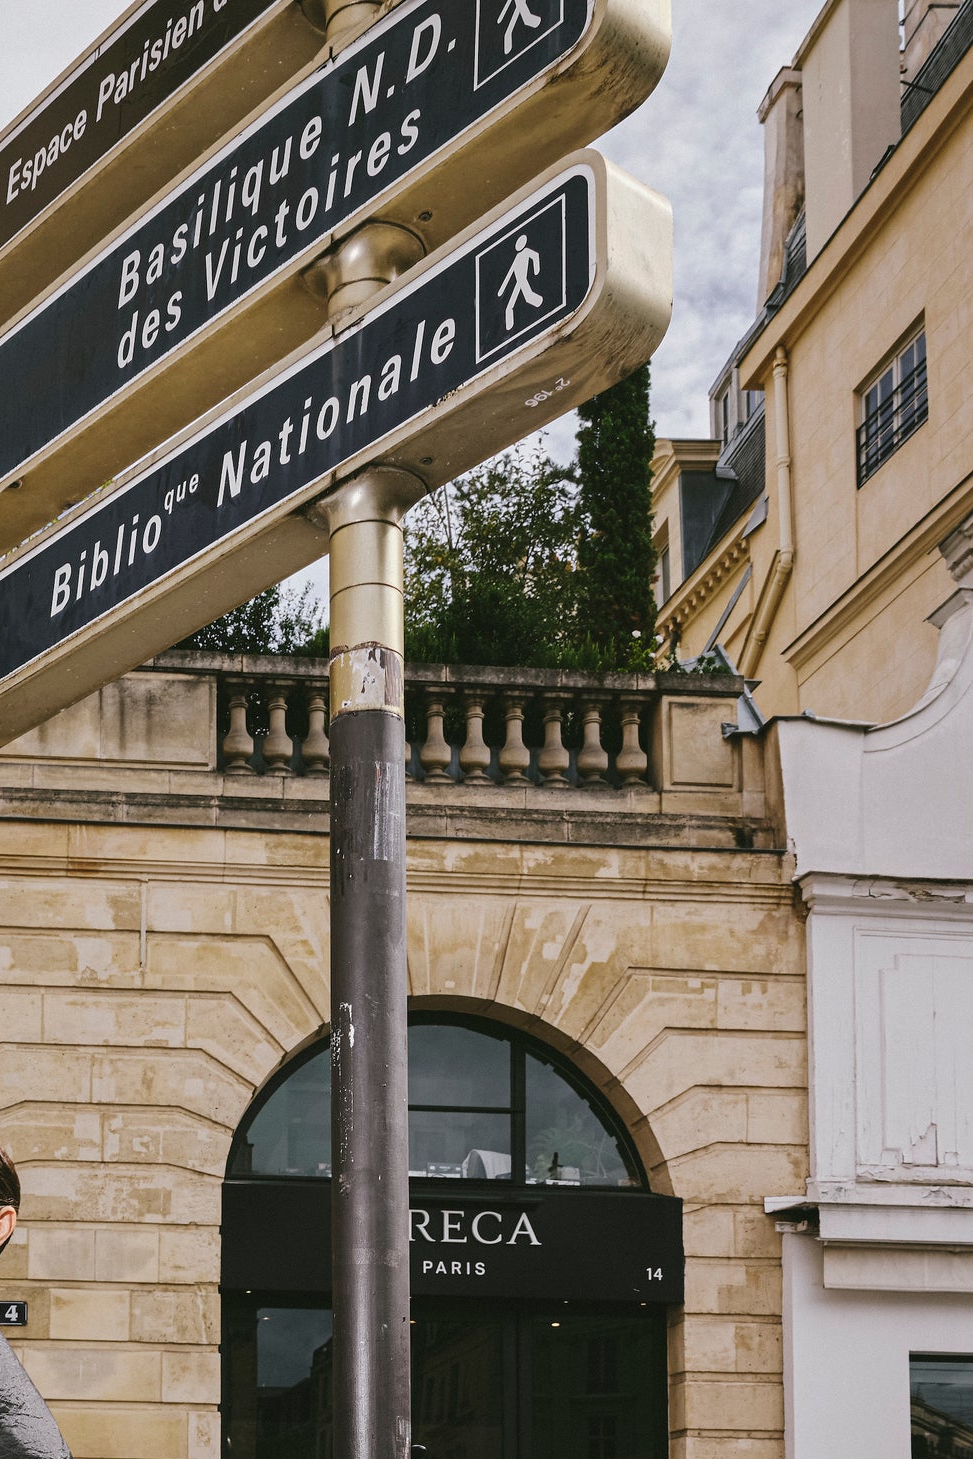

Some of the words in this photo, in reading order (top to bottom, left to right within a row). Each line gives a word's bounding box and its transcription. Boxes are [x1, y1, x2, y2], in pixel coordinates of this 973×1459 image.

[6, 109, 87, 205] Espace
[95, 0, 205, 123] Parisien
[118, 115, 323, 310] Basilique
[348, 13, 457, 127] N.D.
[117, 290, 183, 370] des
[204, 108, 421, 302] Victoires
[216, 317, 456, 508] Nationale
[524, 389, 554, 408] 196
[408, 1208, 543, 1246] RECA
[422, 1260, 486, 1276] PARIS
[646, 1267, 664, 1281] 14
[4, 1304, 19, 1322] 4
